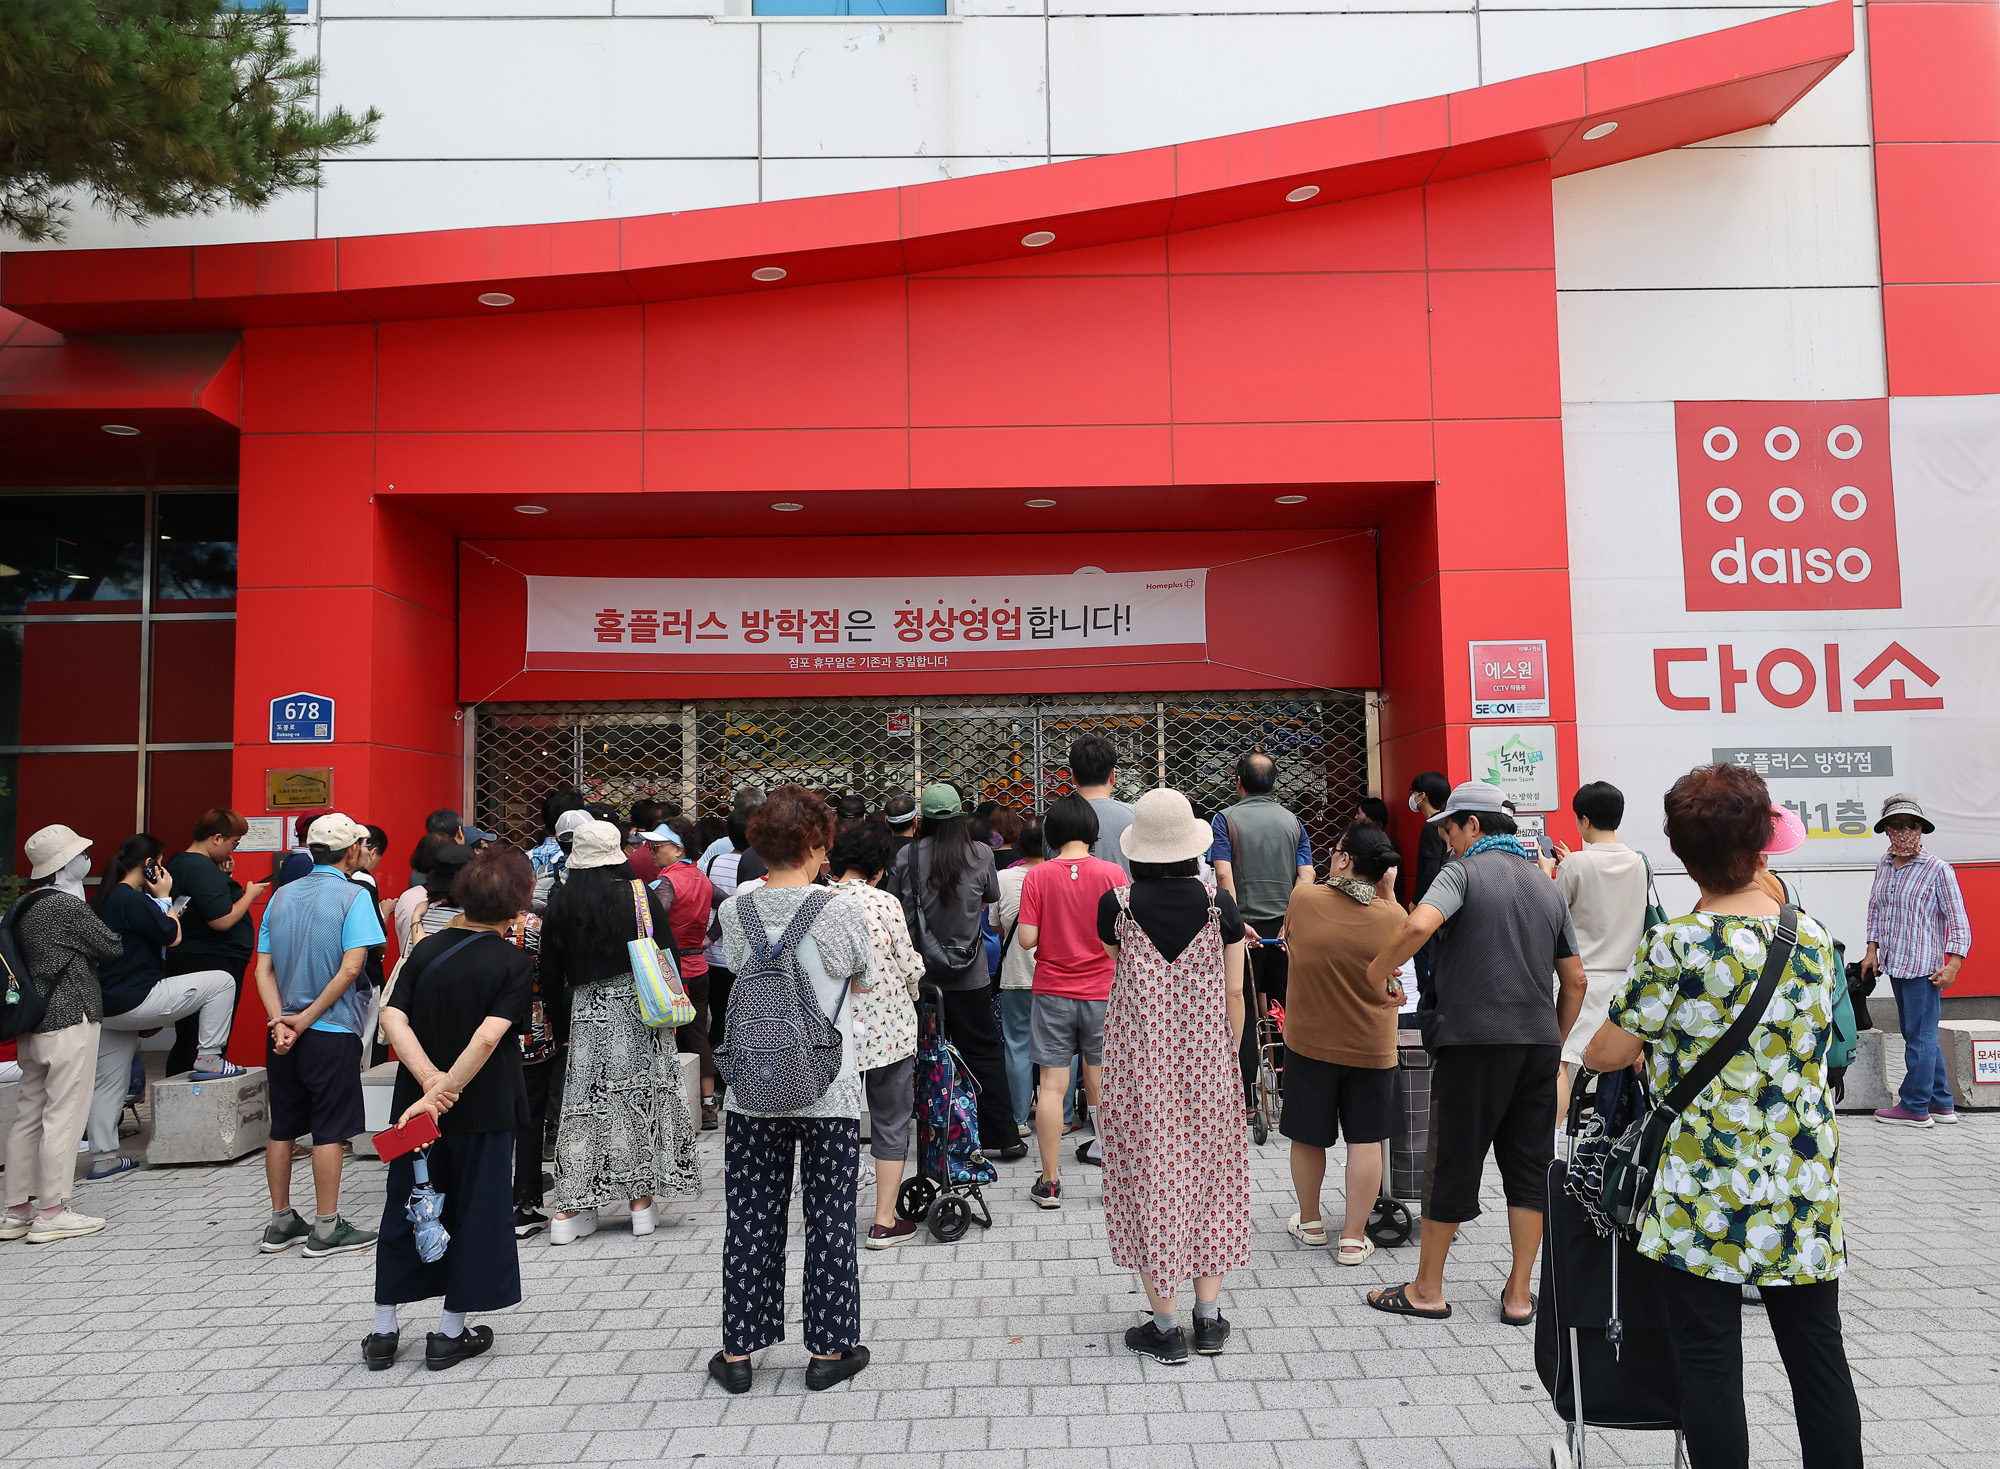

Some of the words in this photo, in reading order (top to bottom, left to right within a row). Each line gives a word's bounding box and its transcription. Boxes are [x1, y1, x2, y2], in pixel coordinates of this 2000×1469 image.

[1710, 537, 1872, 584] daiso
[594, 607, 728, 644] 홈플러스
[740, 607, 876, 644] 방학점은
[893, 603, 1132, 643] 정상영업합니다!
[788, 656, 810, 669] 점포
[813, 656, 857, 669] 휴무일은
[859, 655, 892, 668] 기존과
[894, 655, 949, 668] 동일합니다
[1485, 661, 1533, 680] 에스원
[1653, 641, 1944, 714] 다이소
[285, 702, 320, 720] 678
[1475, 703, 1515, 715] SECOM
[276, 724, 295, 732] 도봉로
[1500, 746, 1526, 772] 녹색
[1814, 752, 1873, 774] 방학점
[1512, 764, 1536, 776] 매장
[1519, 792, 1540, 801] 방학점
[639, 898, 652, 927] MALMA
[1979, 1062, 2000, 1074] 부딪
